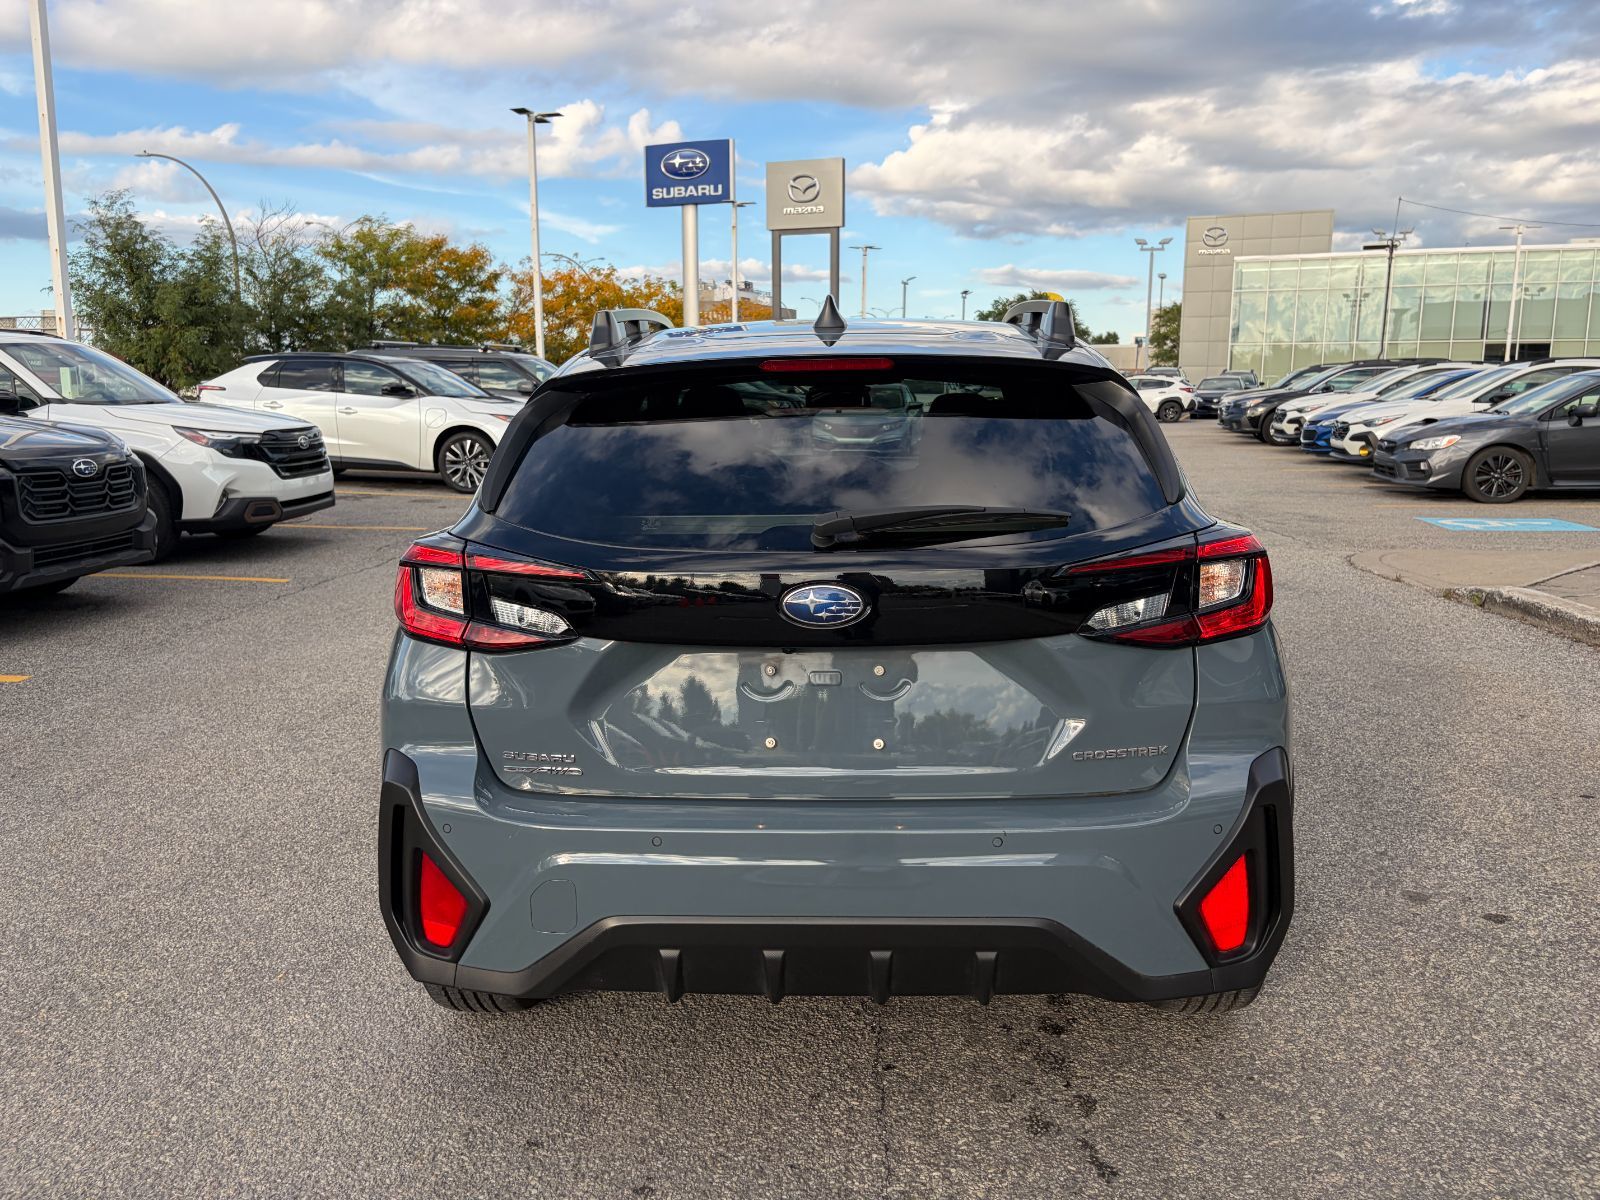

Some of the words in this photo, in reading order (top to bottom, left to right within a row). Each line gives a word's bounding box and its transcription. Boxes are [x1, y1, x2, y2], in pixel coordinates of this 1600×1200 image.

[652, 184, 723, 200] SUBARU
[783, 205, 825, 215] mazda
[502, 750, 576, 763] SUBARU
[1072, 744, 1169, 761] CROSSTREK
